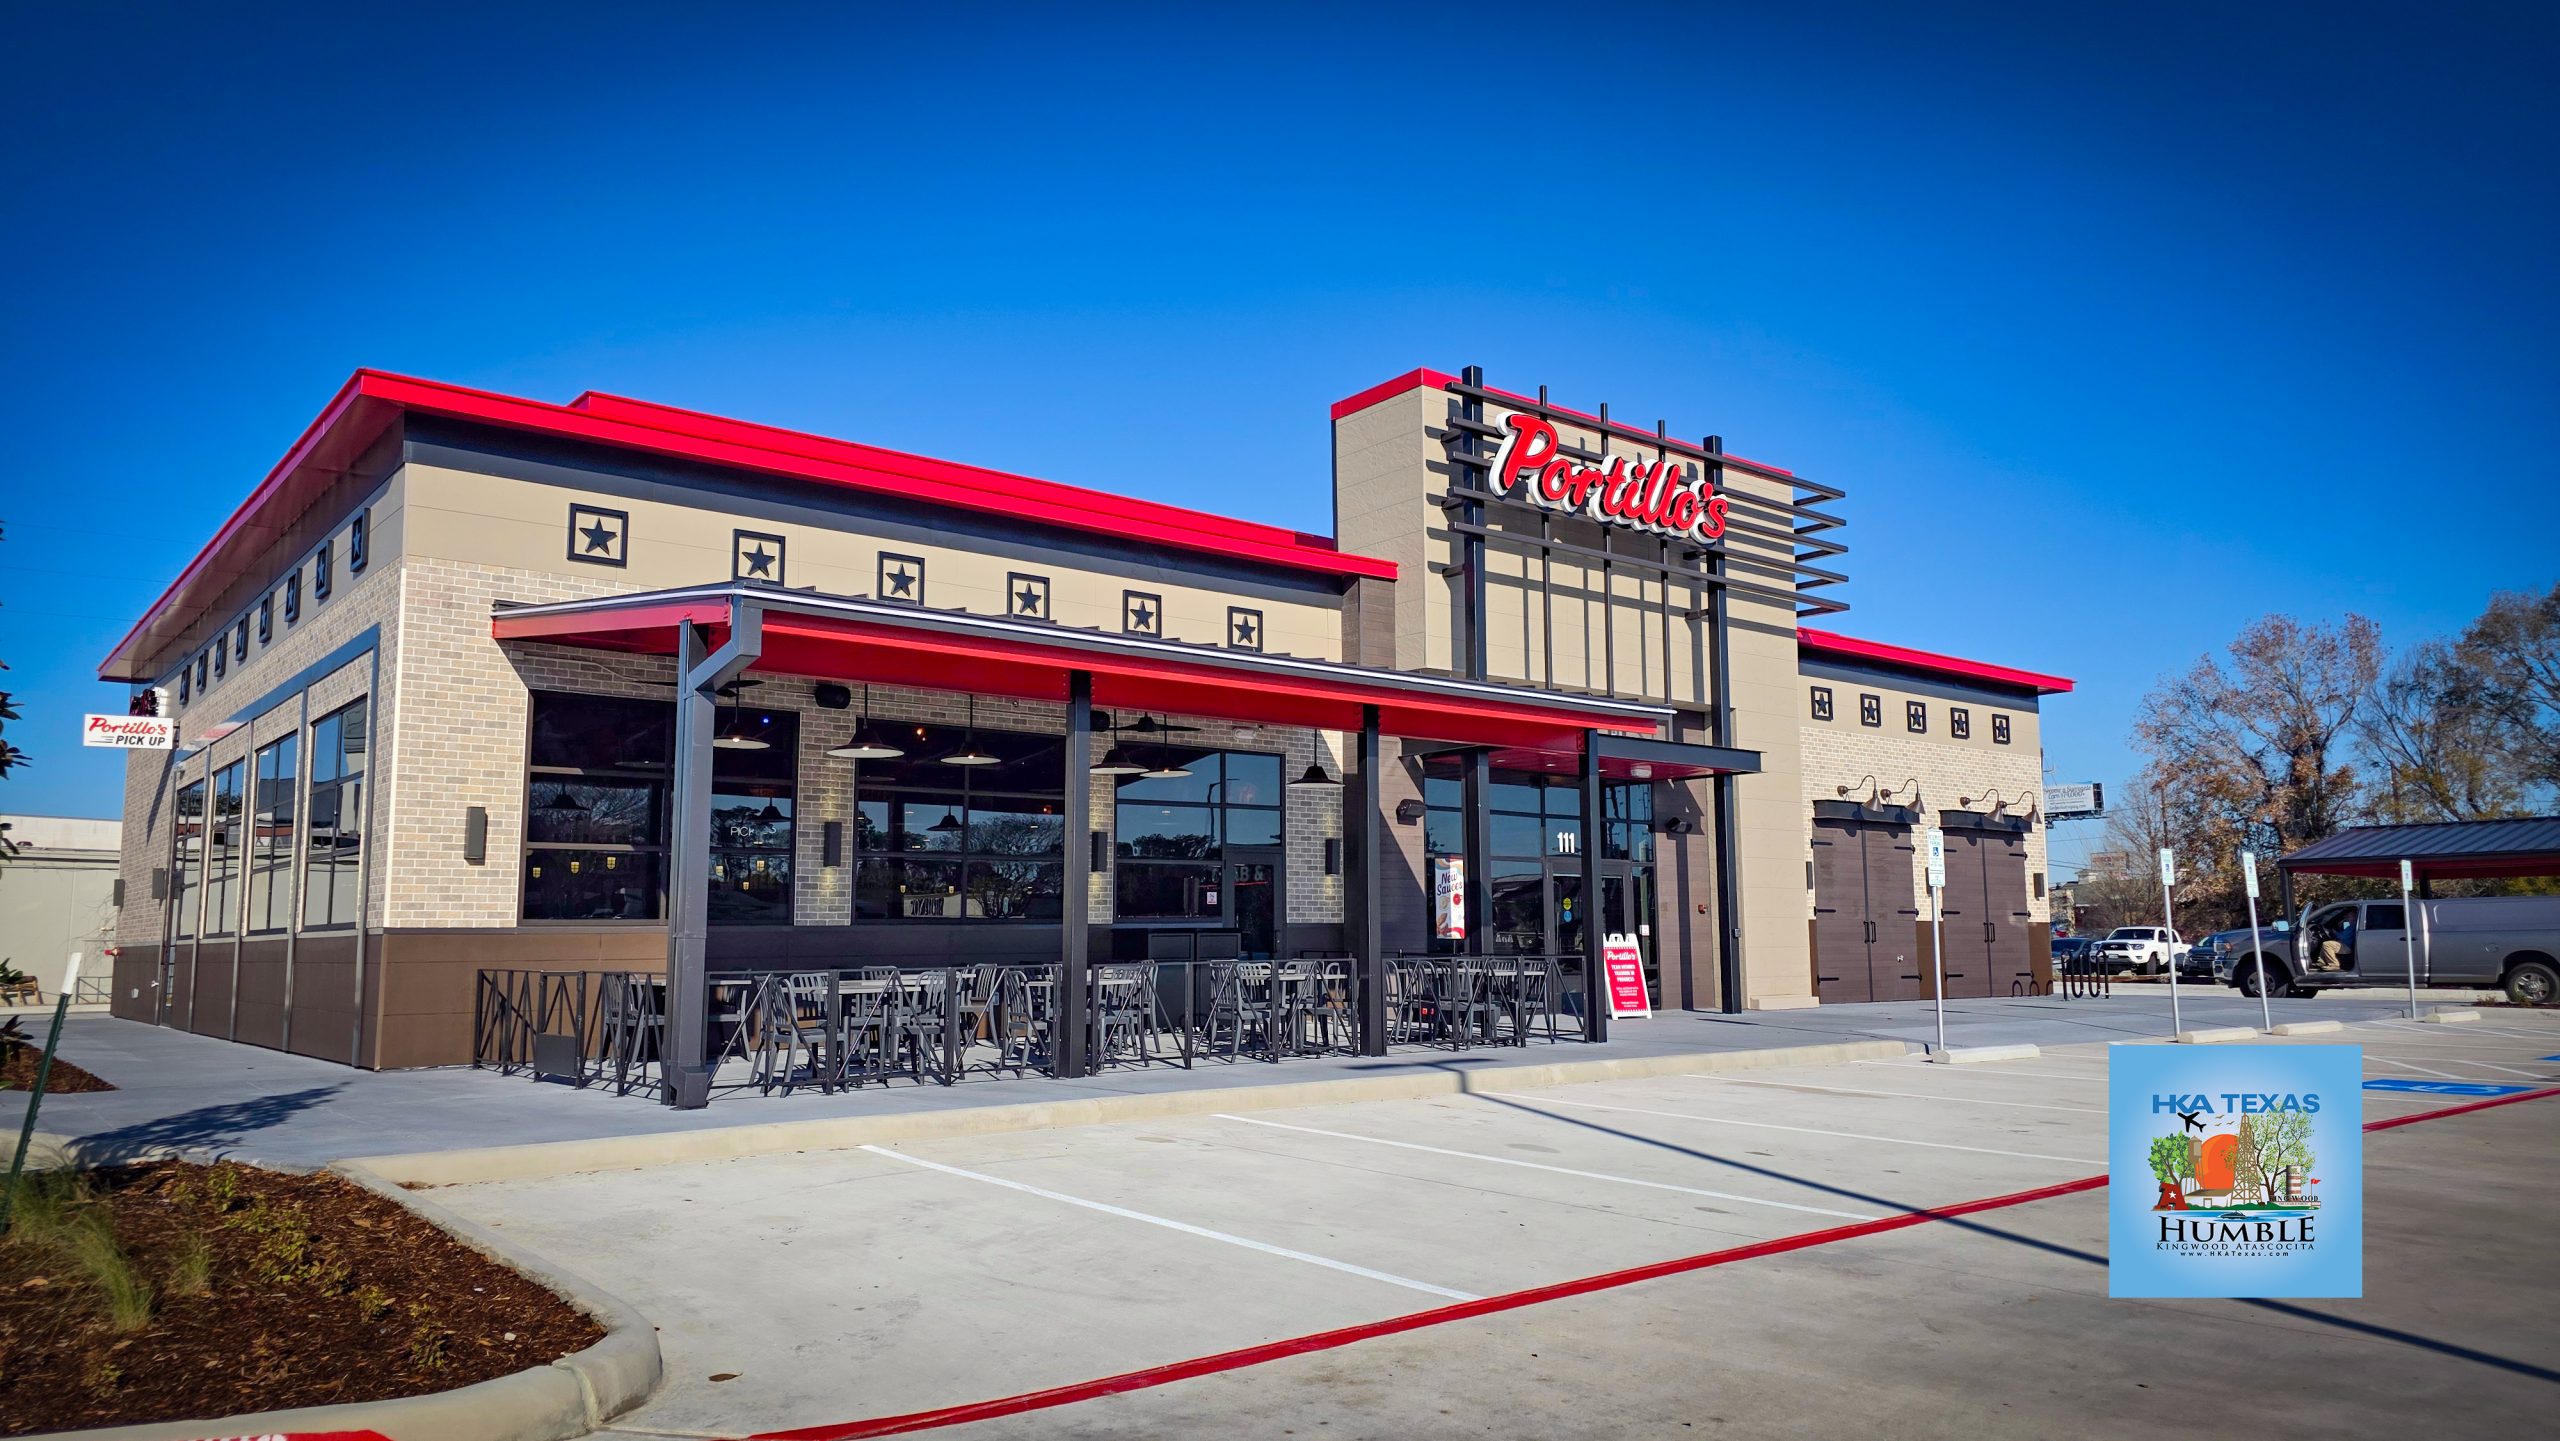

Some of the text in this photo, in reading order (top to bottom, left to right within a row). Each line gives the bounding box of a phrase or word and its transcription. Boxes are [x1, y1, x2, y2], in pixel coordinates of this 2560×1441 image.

[1491, 411, 1729, 544] Portillo's
[89, 717, 168, 736] Portillo's
[115, 735, 166, 746] PICK UP
[730, 824, 777, 837] PICKS
[1557, 831, 1575, 854] 111
[1441, 872, 1458, 885] New
[1437, 882, 1463, 896] Sauces
[1607, 951, 1635, 960] Portillo's
